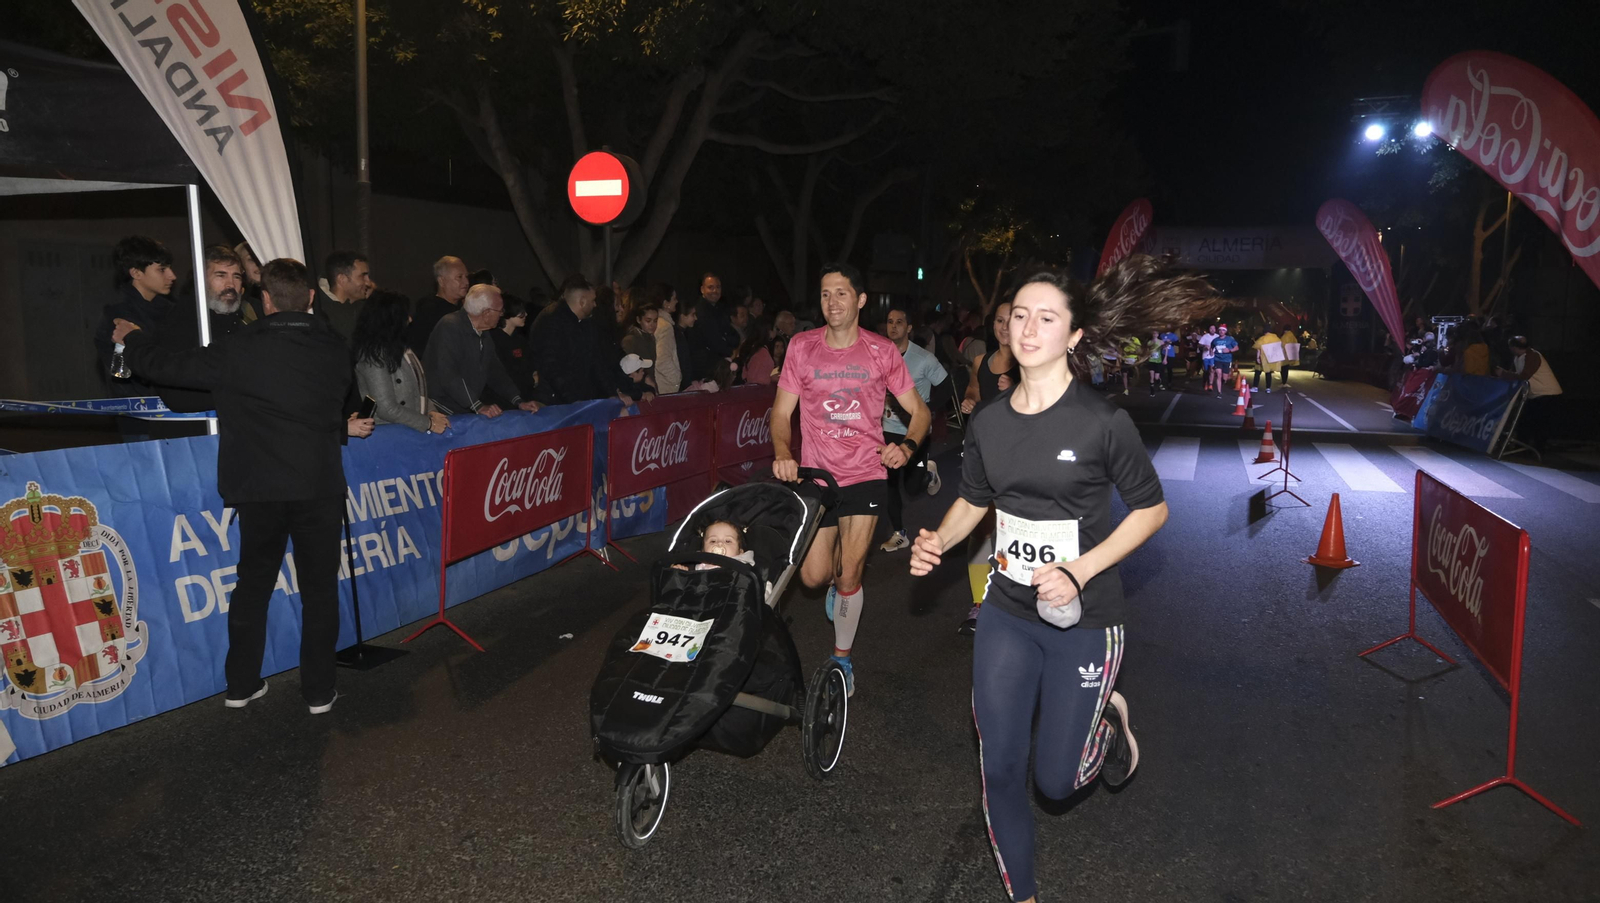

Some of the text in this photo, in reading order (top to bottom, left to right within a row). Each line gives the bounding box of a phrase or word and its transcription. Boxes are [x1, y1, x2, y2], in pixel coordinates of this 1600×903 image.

[1197, 254, 1241, 263] CIUDAD
[1440, 406, 1497, 442] deporte
[631, 420, 691, 475] Coca-Cola
[484, 446, 568, 522] Coca-Cola
[119, 549, 129, 566] POR
[1008, 540, 1056, 563] 496
[1428, 504, 1489, 618] Coca-Cola
[126, 570, 133, 581] LA
[125, 586, 134, 628] LIBERTAD
[655, 631, 695, 647] 947
[33, 679, 125, 714] CIUDAD DE ALMERIA
[633, 691, 665, 704] THULE
